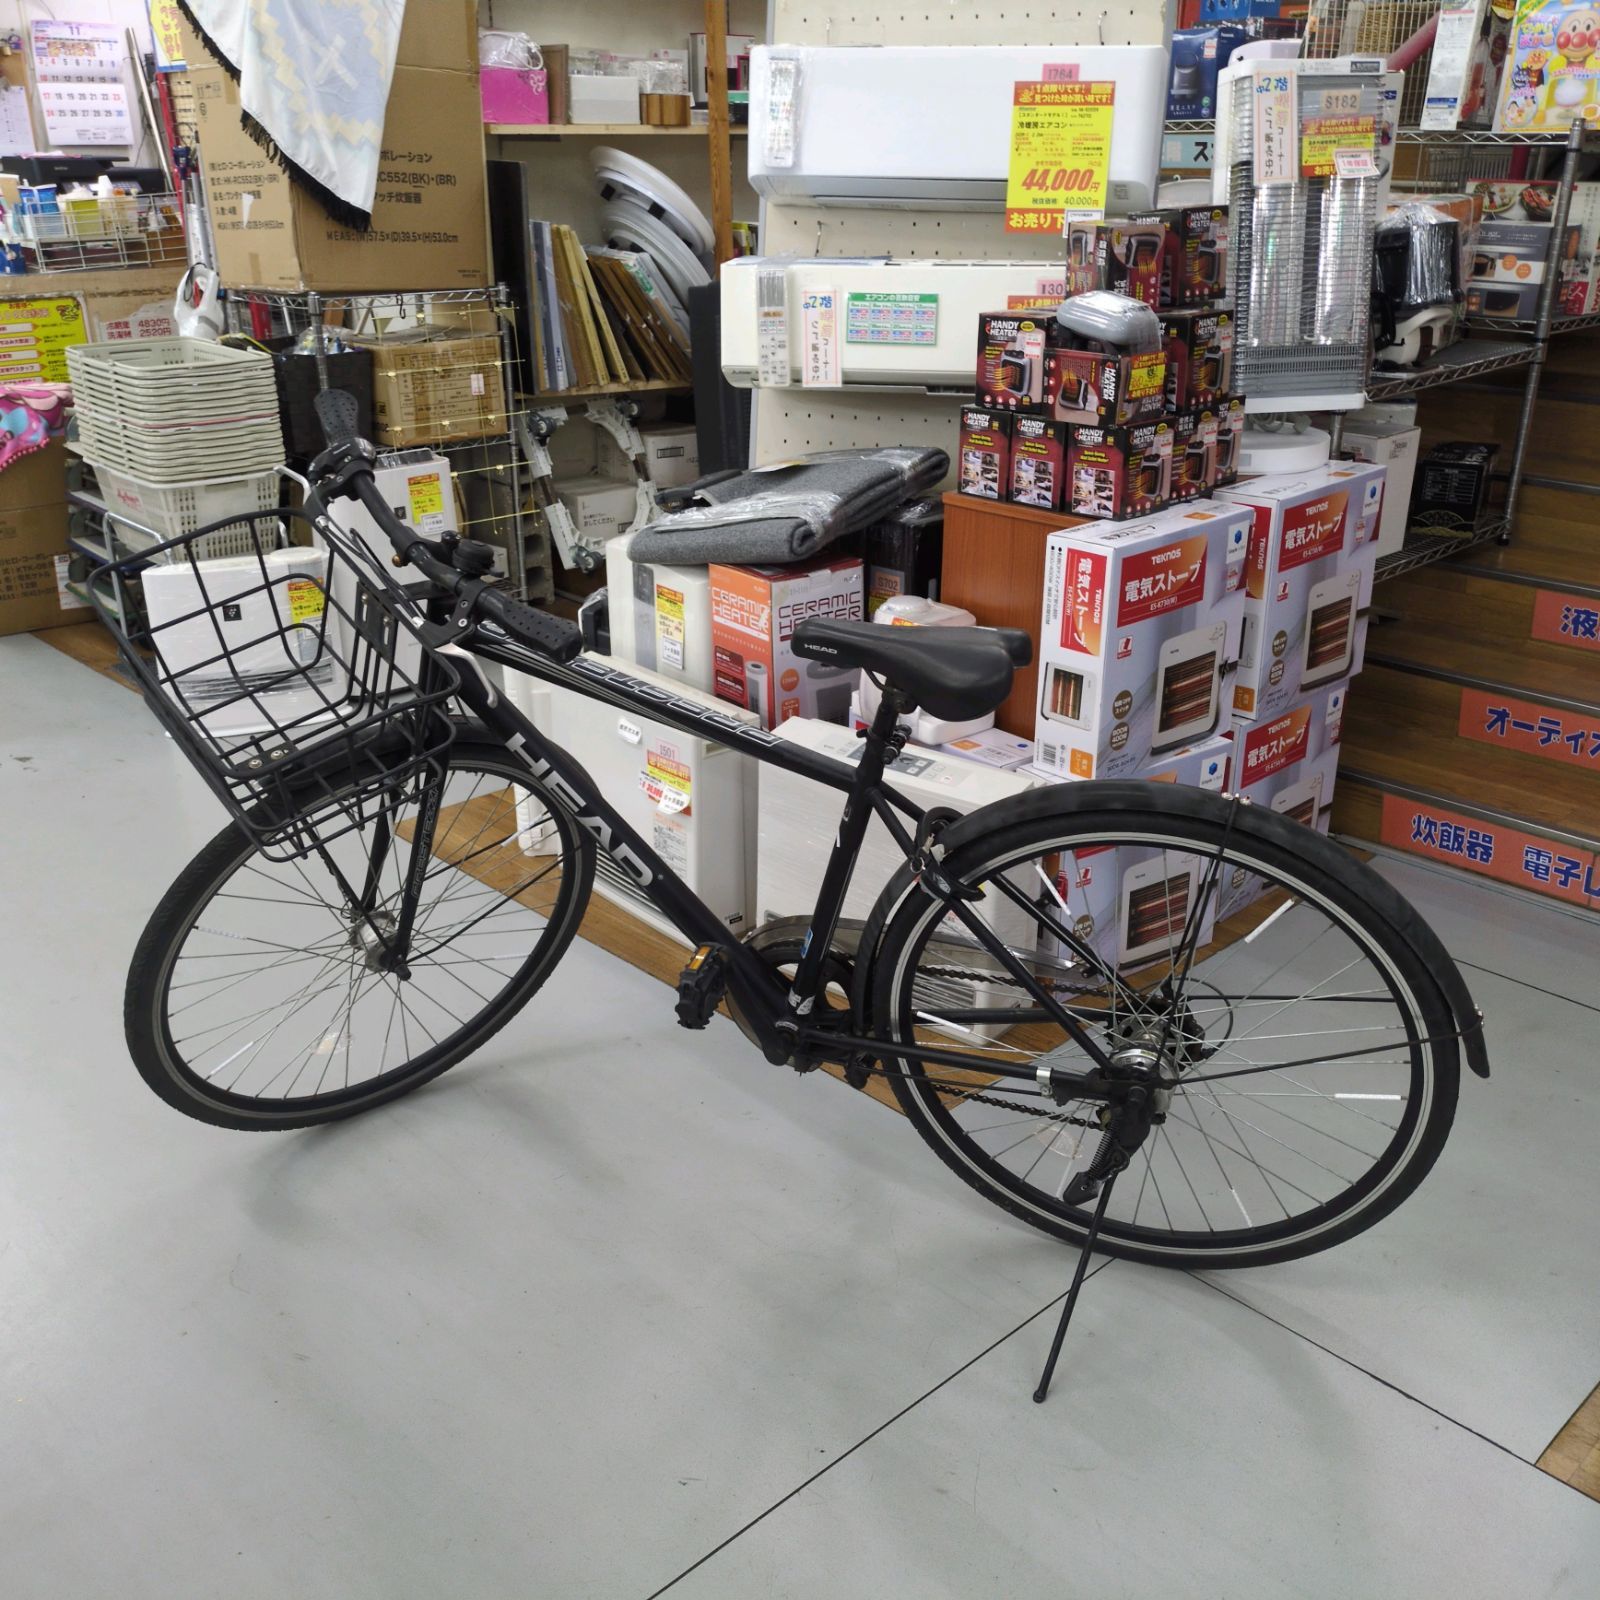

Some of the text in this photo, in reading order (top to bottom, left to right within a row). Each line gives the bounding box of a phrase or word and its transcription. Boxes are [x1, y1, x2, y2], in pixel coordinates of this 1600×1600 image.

[1047, 68, 1074, 81] 1764
[990, 327, 1018, 338] HEATER
[991, 319, 1019, 331] HANDY
[1108, 367, 1117, 402] HANDY
[968, 412, 991, 423] HANDY
[1021, 418, 1046, 430] HANDY
[1133, 425, 1157, 439] HANDY
[1078, 434, 1103, 444] HEATER
[1079, 427, 1105, 438] HANDY
[1285, 512, 1344, 551] 電気ストーブ
[1125, 559, 1203, 602] 電気ストーブ
[711, 586, 771, 615] CERAMIC
[778, 590, 861, 619] CERAMIC
[1074, 558, 1092, 648] 電気ストーブ
[711, 600, 770, 635] HEATER
[1560, 603, 1600, 640] 液
[804, 642, 838, 656] HEAD
[1247, 728, 1306, 768] 電気ストーブ
[504, 731, 654, 888] HEAD
[1410, 812, 1495, 866] 炊飯器
